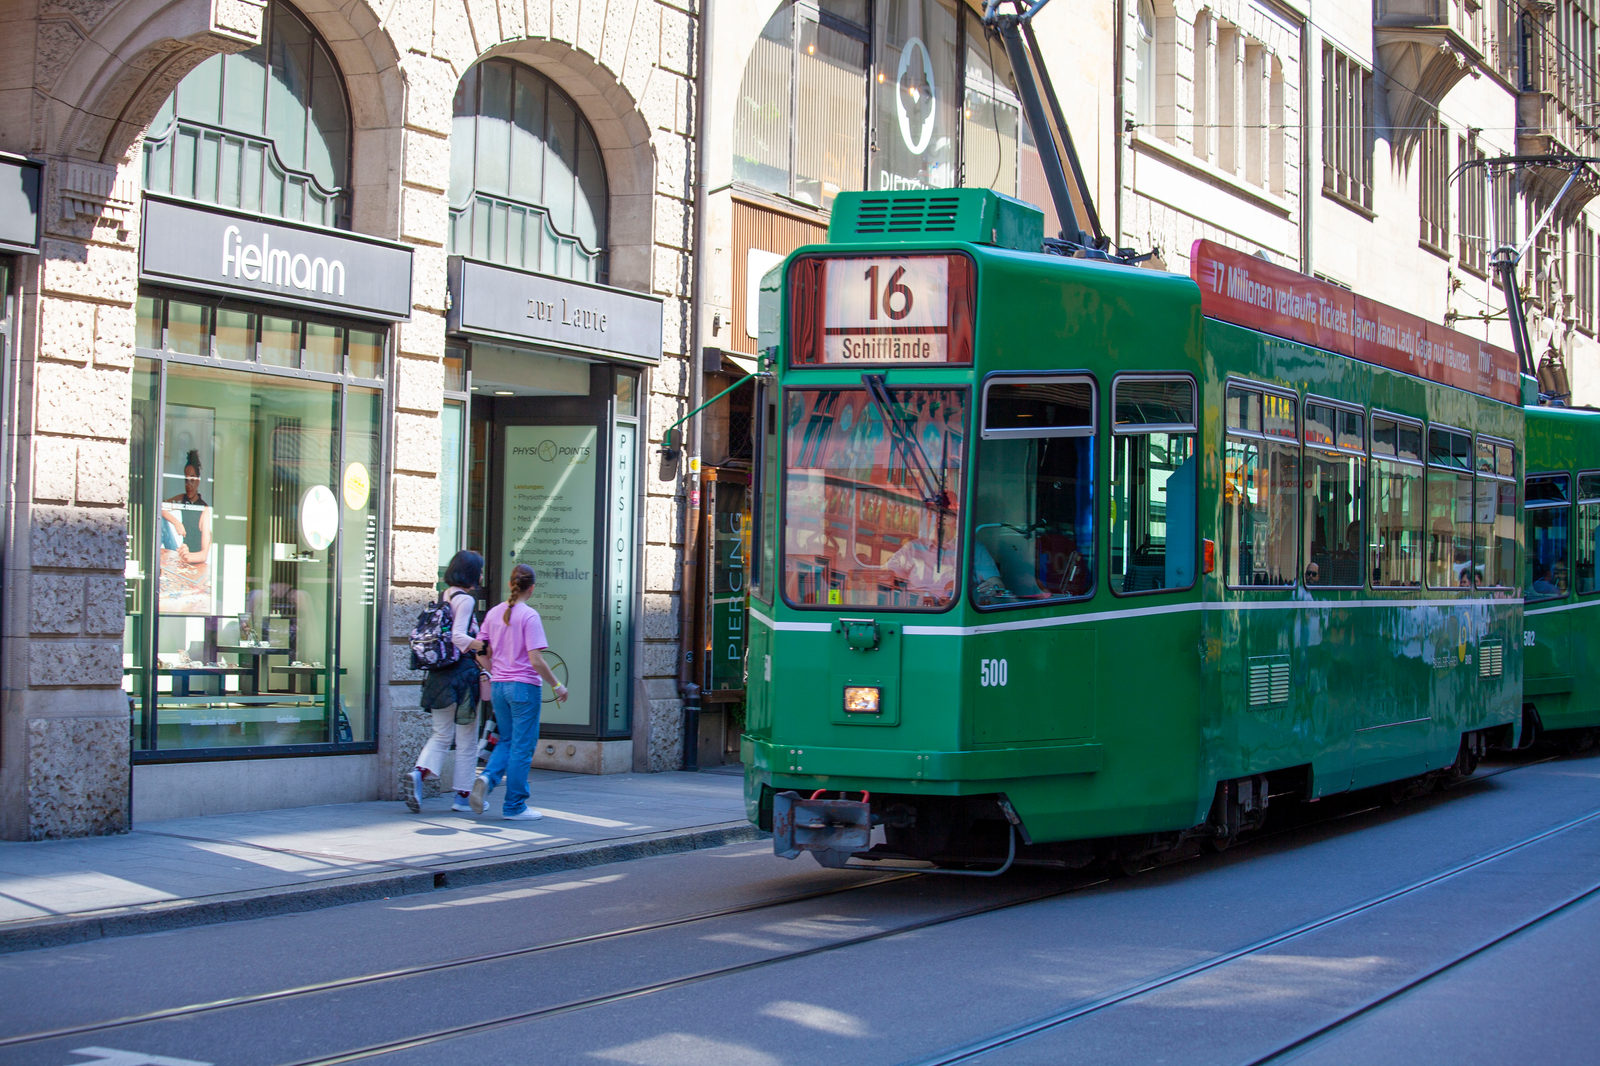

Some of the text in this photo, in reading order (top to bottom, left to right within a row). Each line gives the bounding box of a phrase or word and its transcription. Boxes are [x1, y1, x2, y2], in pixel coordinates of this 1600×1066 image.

[222, 225, 345, 297] fielmann
[526, 298, 608, 333] zur Laute
[864, 265, 914, 321] 16
[1227, 265, 1272, 310] Millionen
[1275, 286, 1316, 324] verkaufte
[1318, 297, 1349, 335] Tickets.
[1350, 308, 1376, 342] Davon
[1377, 316, 1396, 350] kann
[1396, 323, 1415, 361] Lady
[1415, 331, 1432, 366] Gaga
[1433, 343, 1445, 364] nur
[842, 338, 930, 359] Schifflände
[613, 434, 627, 719] PHYSIOTHERAPIE
[727, 512, 743, 660] PIERCING
[1523, 630, 1536, 647] 502
[980, 658, 1008, 687] 500
